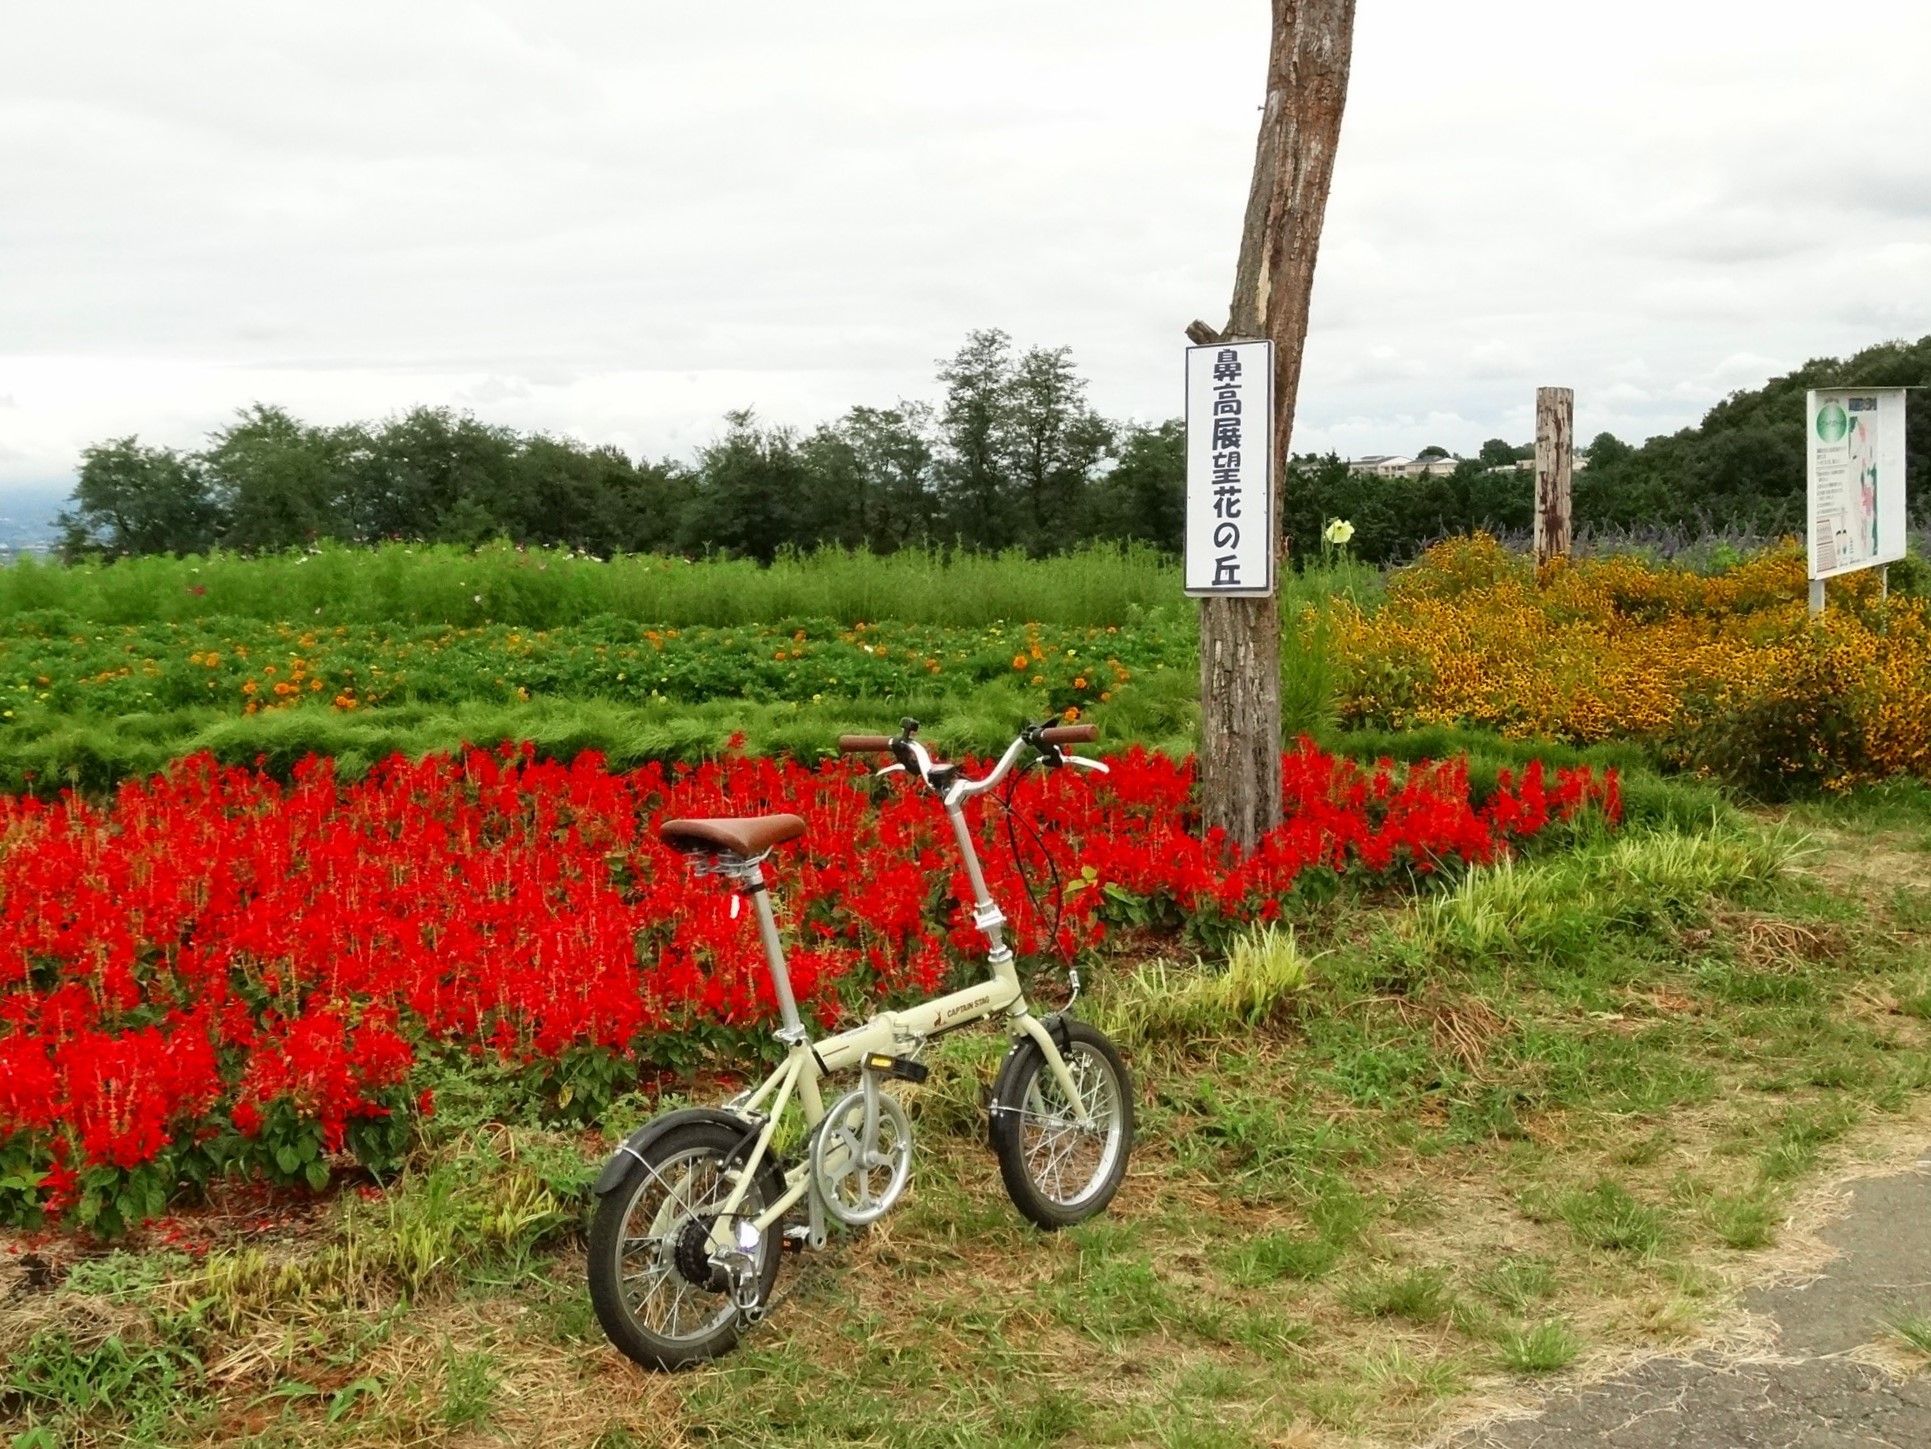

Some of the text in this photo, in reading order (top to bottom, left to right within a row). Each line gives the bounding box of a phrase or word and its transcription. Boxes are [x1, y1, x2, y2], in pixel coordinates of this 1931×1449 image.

[1212, 348, 1242, 586] 鼻高展望花の丘
[947, 1001, 974, 1018] CAPTAIN
